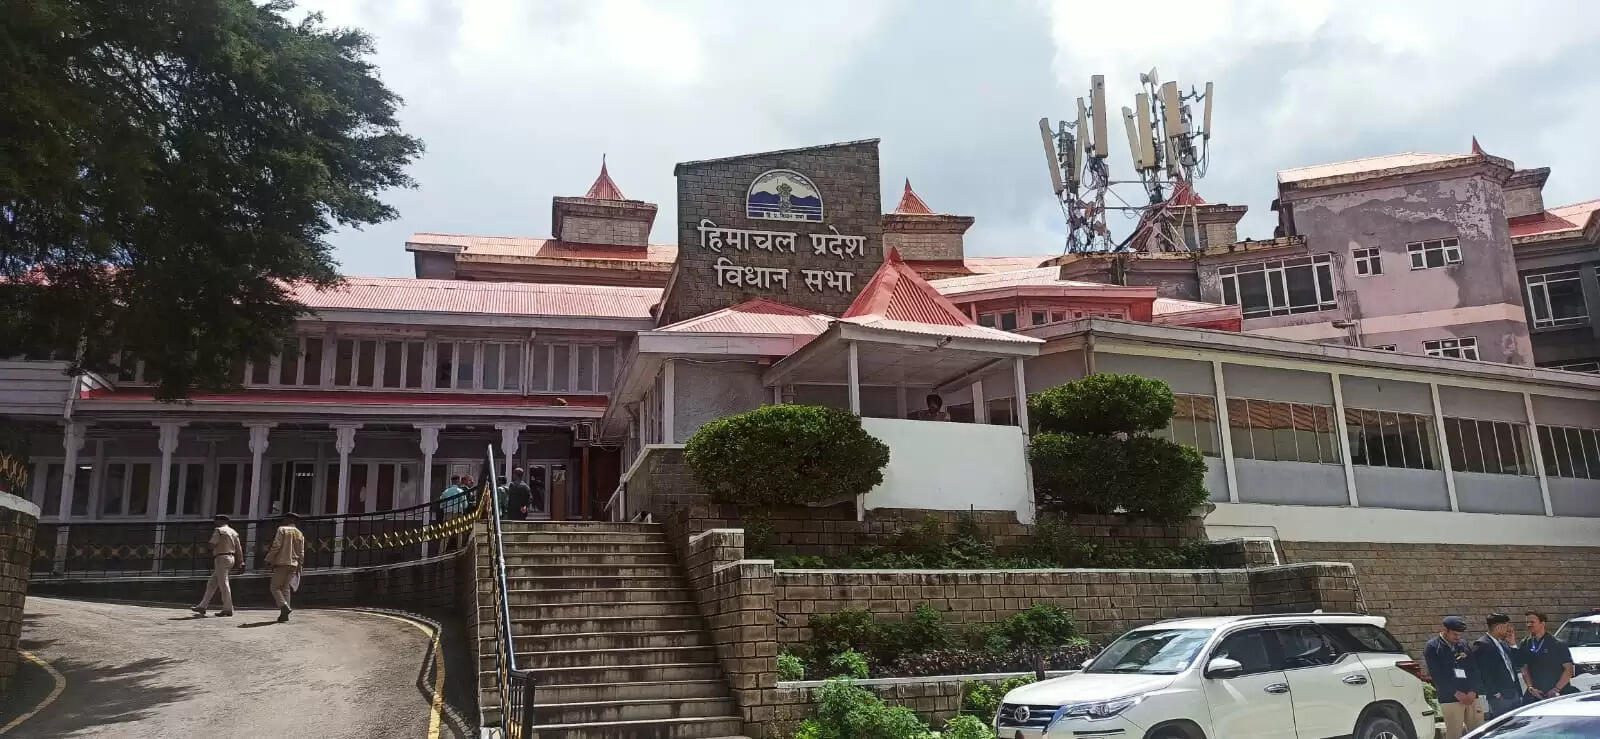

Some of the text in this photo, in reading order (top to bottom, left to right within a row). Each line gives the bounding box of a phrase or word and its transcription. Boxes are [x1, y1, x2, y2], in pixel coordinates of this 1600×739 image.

[697, 218, 867, 260] हिमाचल प्रदेश
[713, 256, 855, 293] विधान सभा
